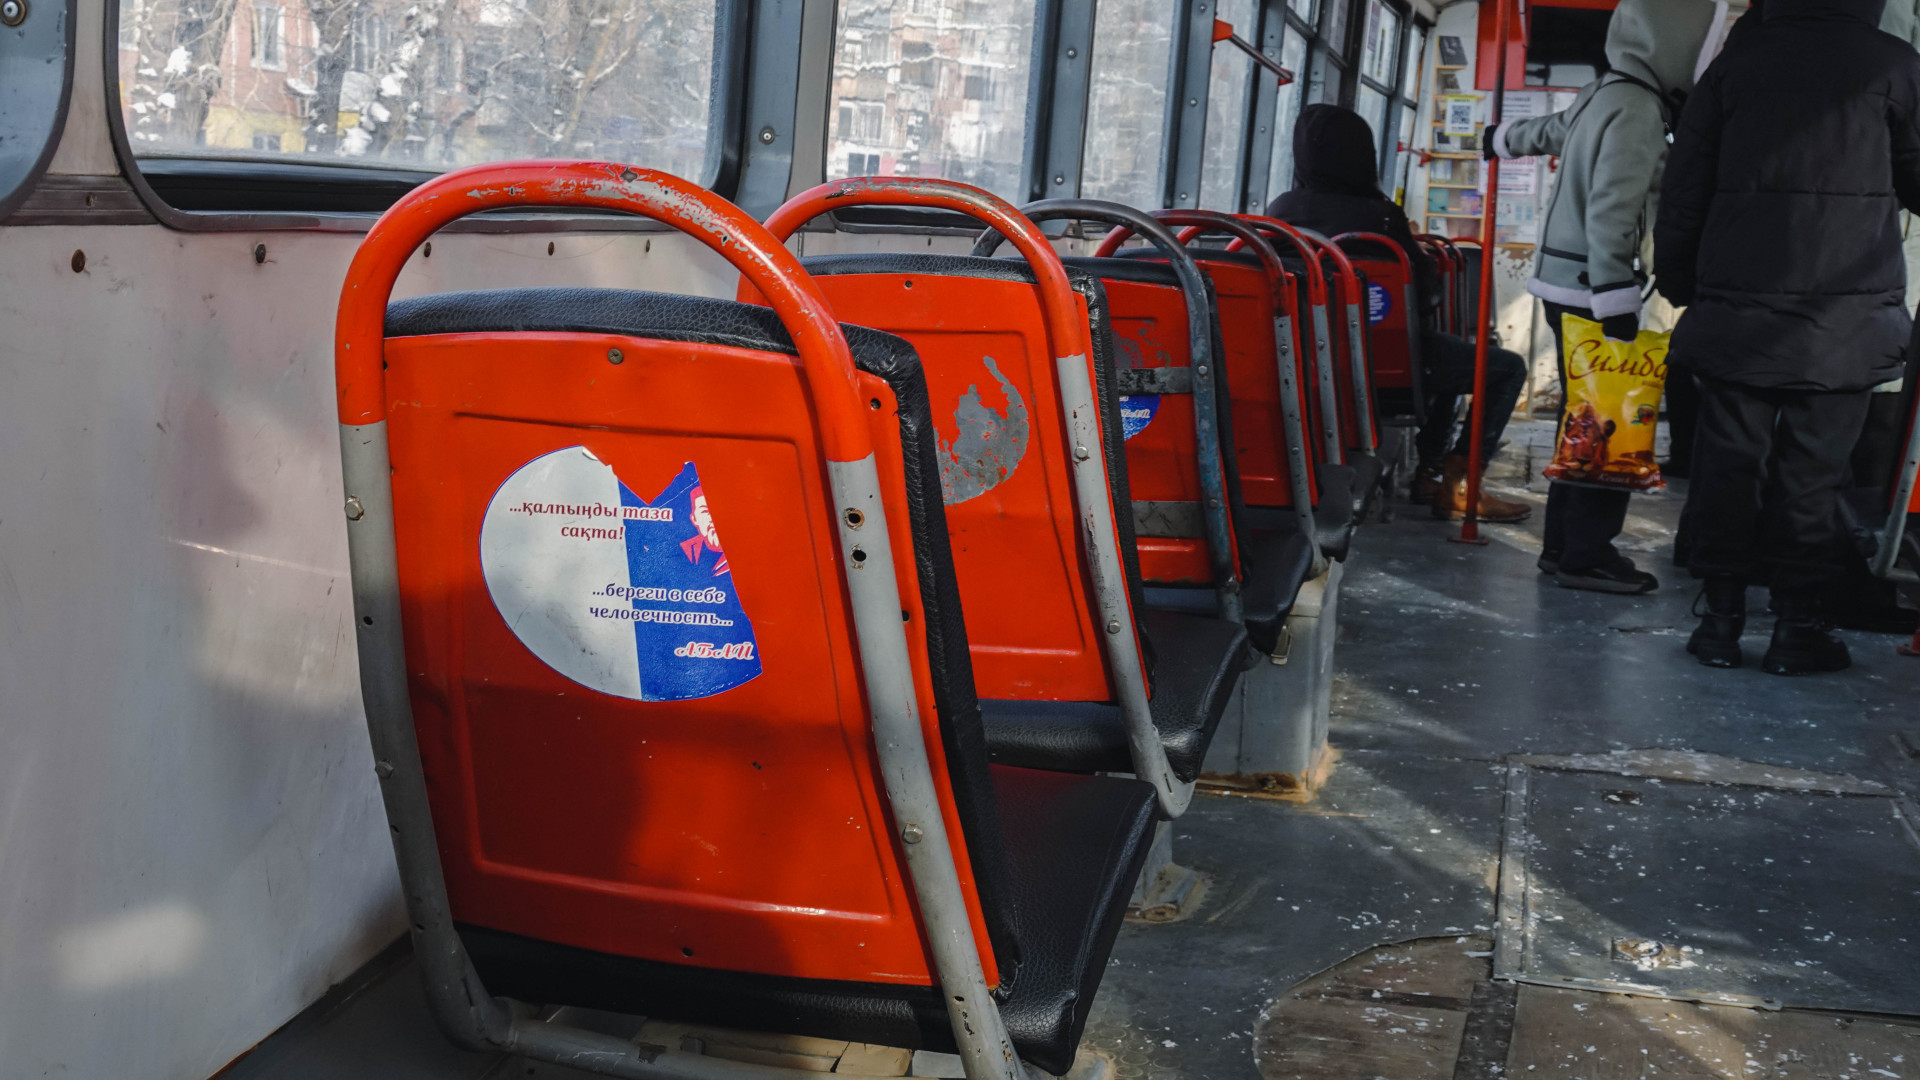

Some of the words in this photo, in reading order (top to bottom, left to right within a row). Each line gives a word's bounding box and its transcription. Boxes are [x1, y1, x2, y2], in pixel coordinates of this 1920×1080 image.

[1568, 339, 1669, 381] Симба
[509, 502, 618, 519] ...қалпыңды
[622, 506, 672, 521] таза
[561, 526, 624, 541] сақта!
[592, 582, 665, 601] ...береги
[669, 589, 681, 601] в
[685, 587, 725, 603] себе
[589, 606, 733, 626] человечность...
[675, 641, 754, 660] АБАЙ
